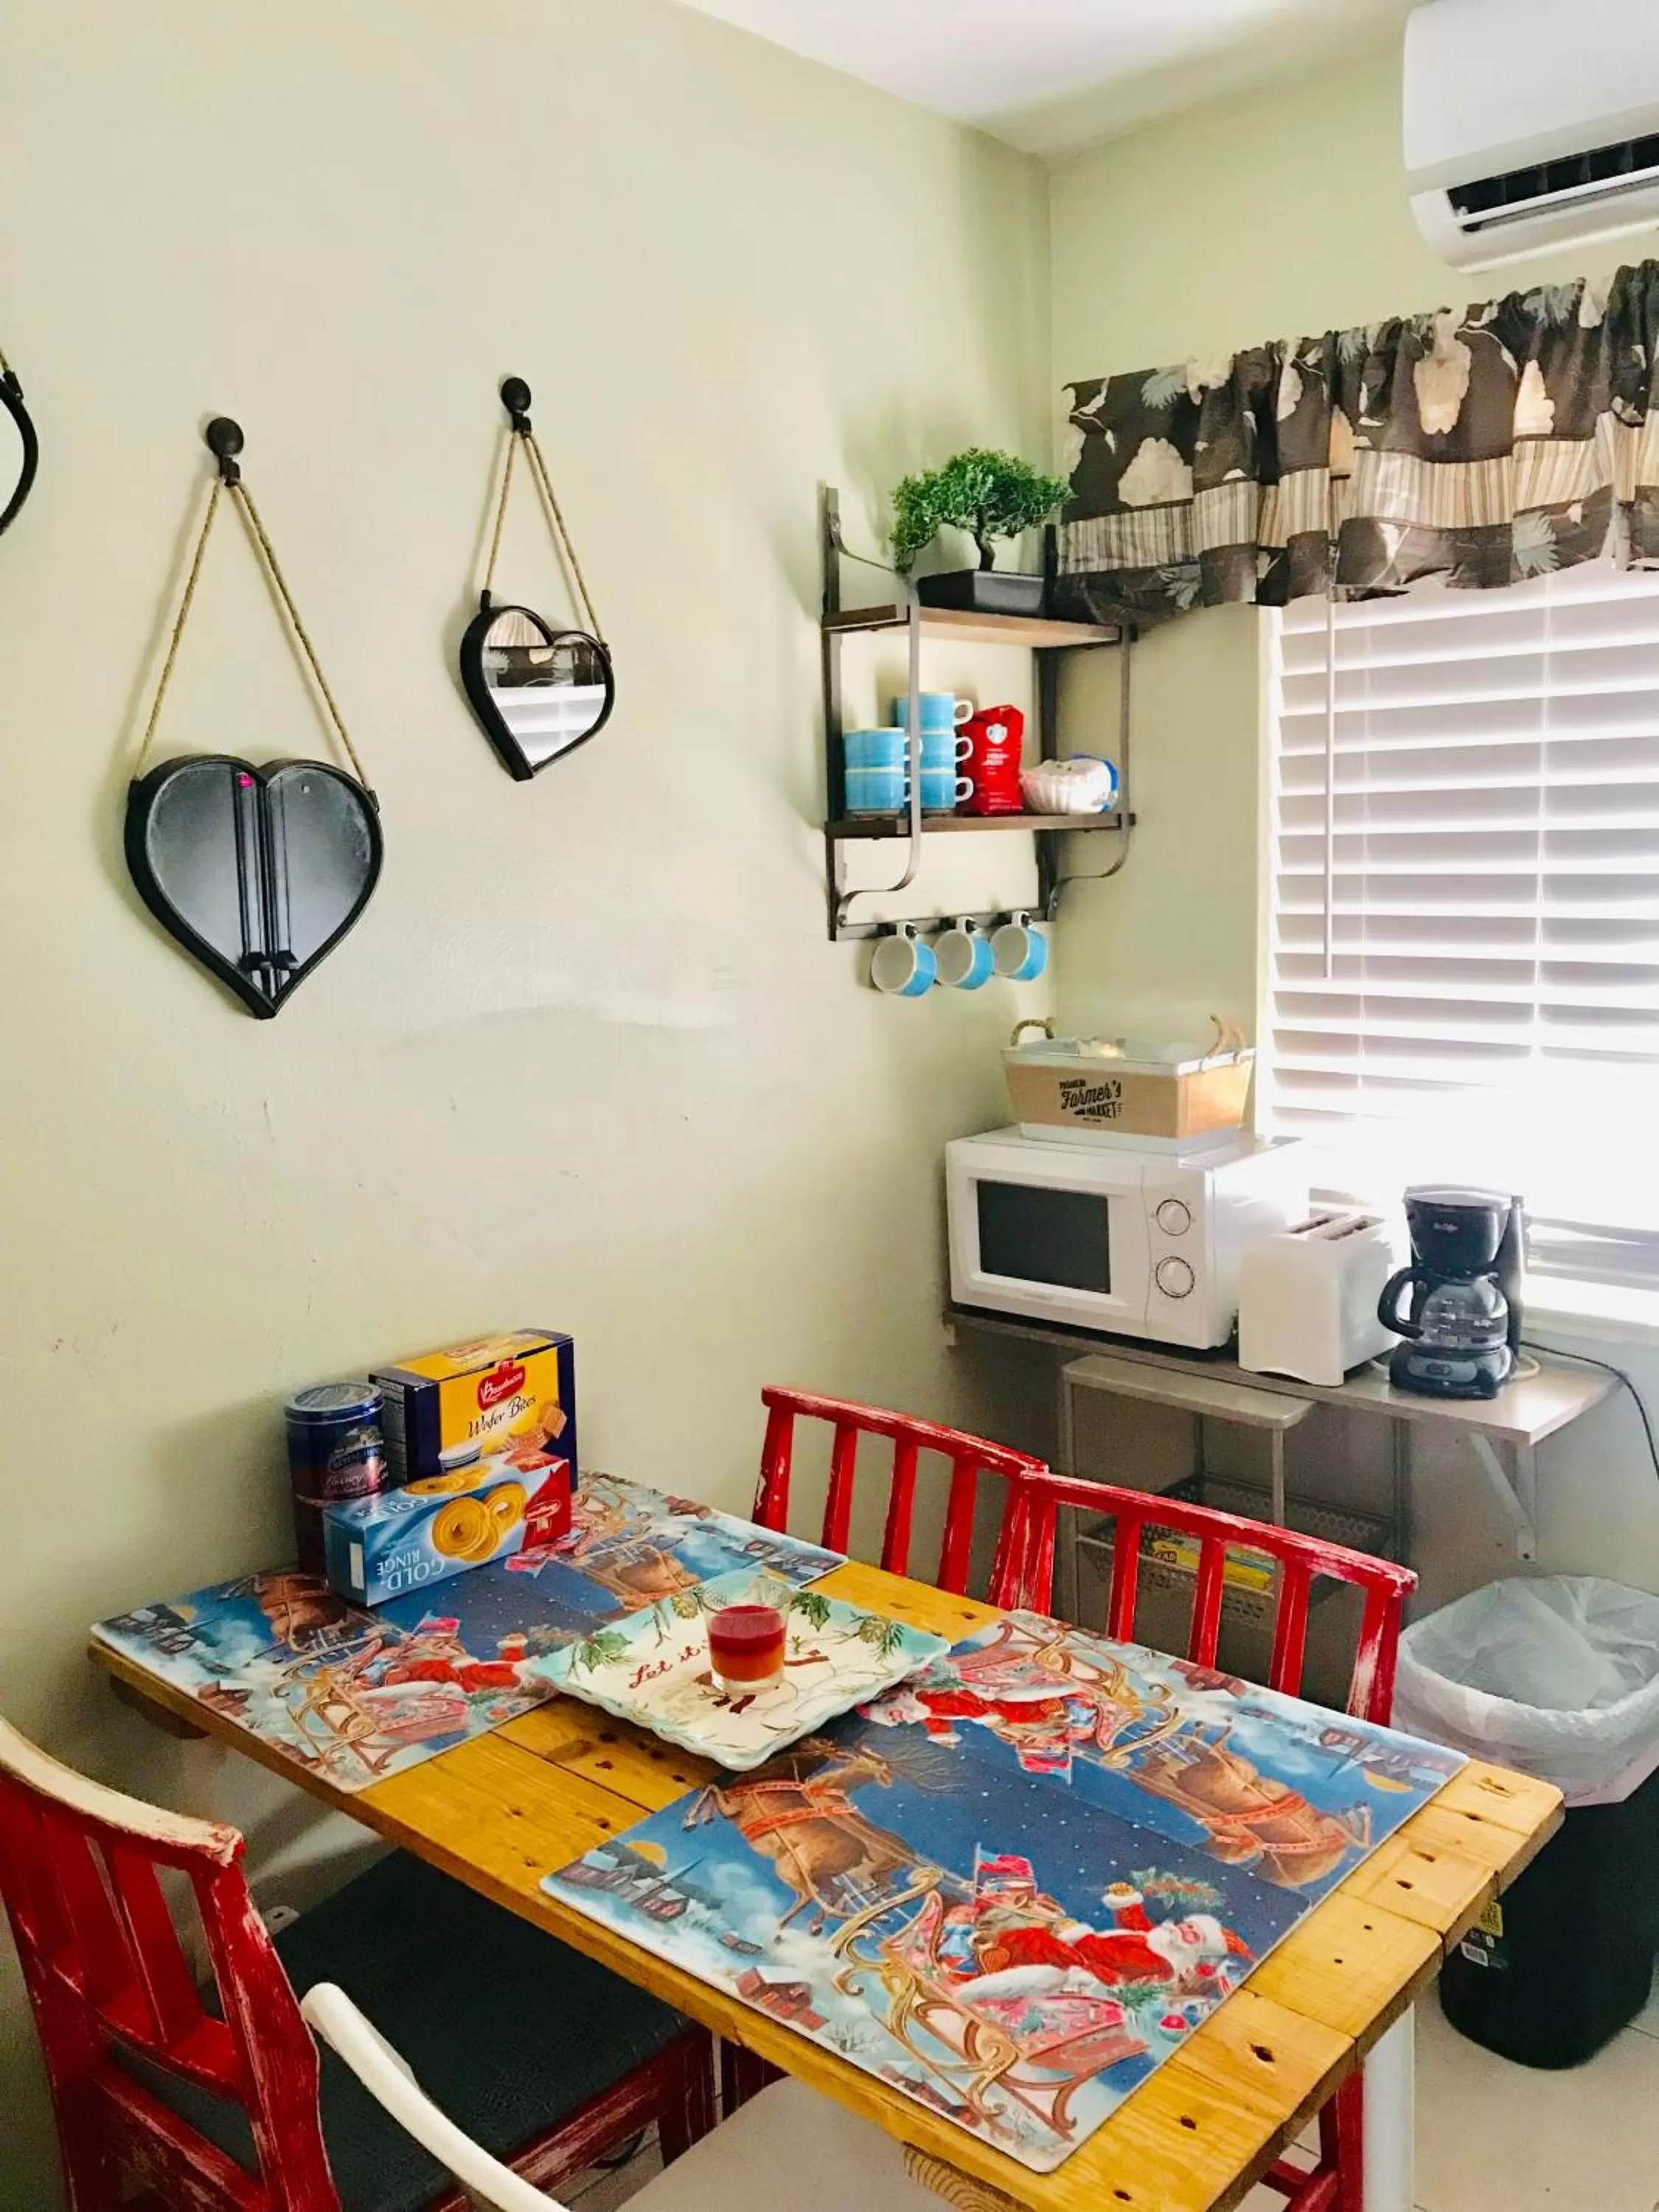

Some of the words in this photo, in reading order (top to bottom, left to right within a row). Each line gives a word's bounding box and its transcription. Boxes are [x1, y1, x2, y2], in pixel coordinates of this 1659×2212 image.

[1061, 1079, 1121, 1110] Farmer's
[468, 1410, 505, 1439] Wafer
[508, 1394, 537, 1419] Bites
[377, 1548, 420, 1576] RINGE
[628, 1660, 673, 1688] Let
[679, 1645, 701, 1663] it
